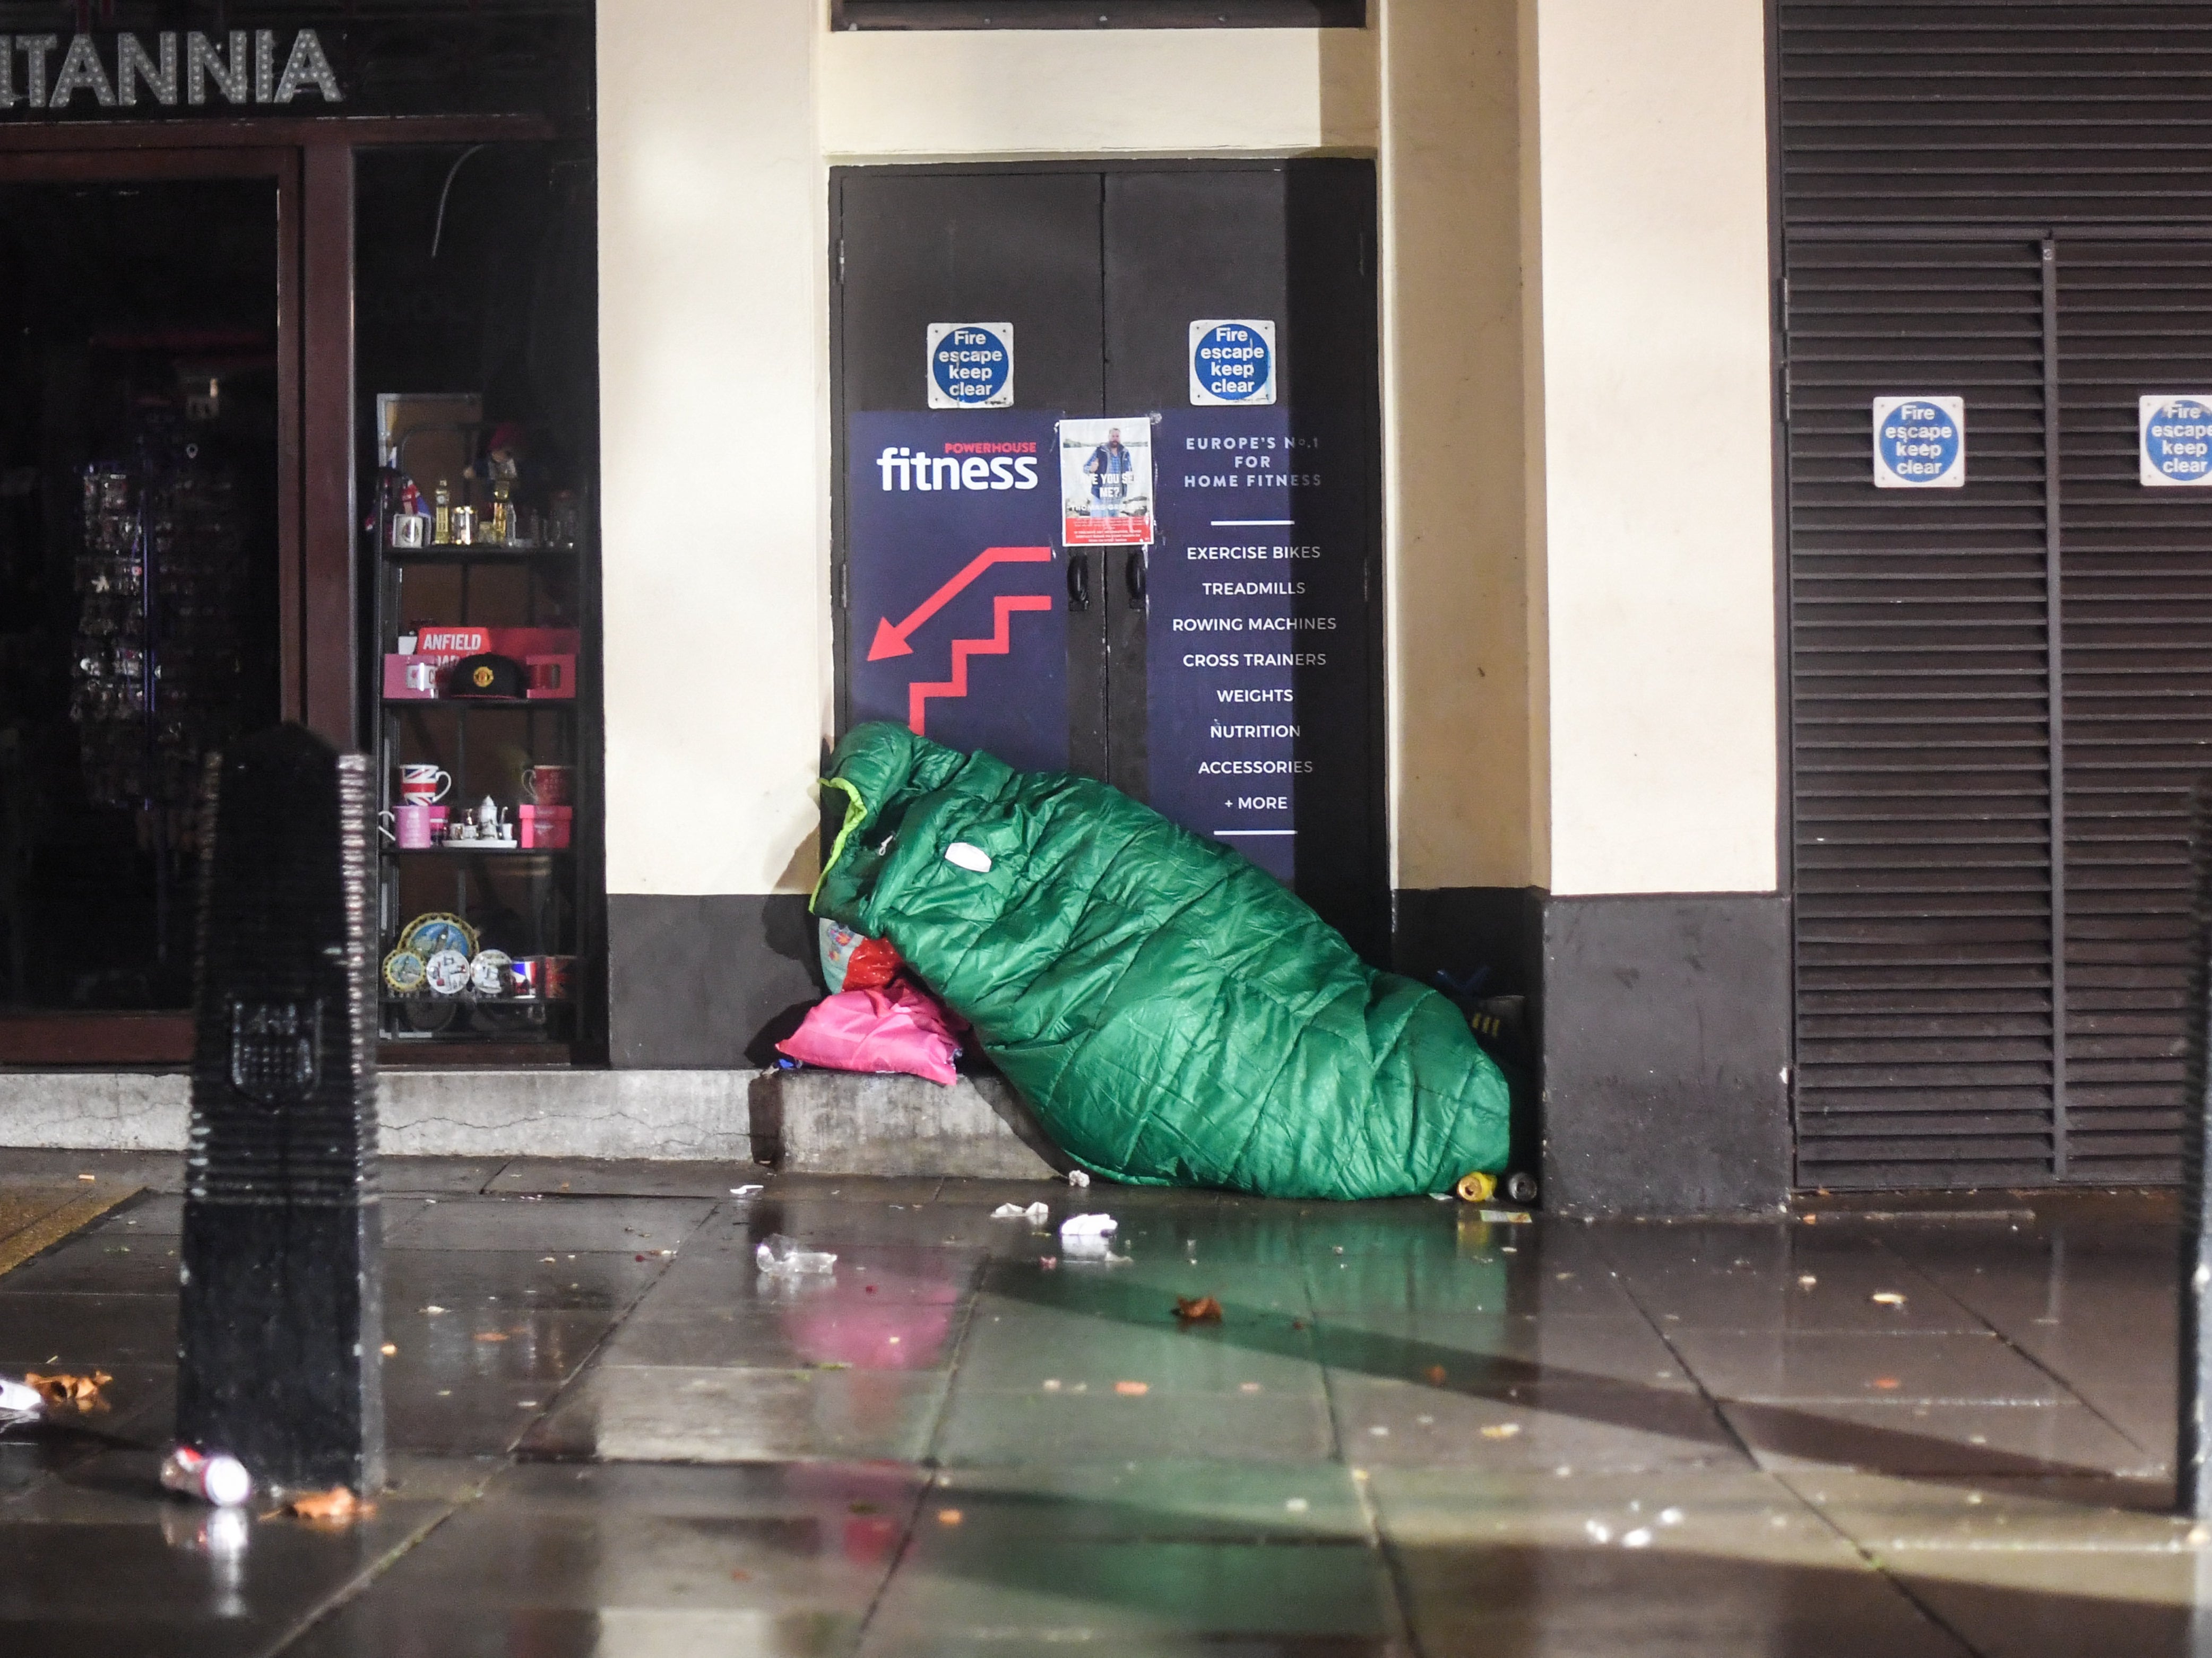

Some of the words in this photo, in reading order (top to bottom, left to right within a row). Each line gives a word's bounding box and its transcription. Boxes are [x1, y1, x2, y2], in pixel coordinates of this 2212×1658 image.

[0, 29, 341, 108] ITANNIA
[954, 330, 986, 345] Fire
[1216, 327, 1248, 342] Fire
[938, 350, 1003, 364] escape
[1200, 346, 1265, 361] escape
[948, 364, 992, 381] keep
[1211, 361, 1255, 379] keep
[948, 381, 993, 396] clear
[1211, 378, 1255, 393] clear
[1900, 404, 1935, 421] Fire
[2167, 403, 2202, 419] Fire
[1884, 426, 1953, 441] escape
[944, 442, 1036, 454] POWERHOUSE
[1186, 437, 1276, 450] EUROPE'S
[1895, 441, 1942, 459] keep
[2162, 439, 2208, 457] keep
[876, 447, 1038, 491] fitness
[1234, 455, 1271, 468] FOR
[1896, 459, 1942, 475] clear
[2162, 457, 2208, 473] clear
[1100, 473, 1120, 484] YOU
[1185, 475, 1238, 488] HOME
[1247, 474, 1321, 487] FITNESS
[1099, 487, 1119, 498] ME?
[1187, 546, 1268, 560] EXERCISE
[1272, 546, 1320, 559] BIKES
[1202, 581, 1306, 595] TREADMILLS
[1172, 618, 1243, 631] ROWING
[1248, 617, 1337, 631] MACHINES
[423, 633, 481, 650] ANFIELD
[1182, 653, 1239, 667] CROSS
[1243, 653, 1327, 666] TRAINERS
[1216, 689, 1294, 702] WEIGHTS
[1210, 725, 1301, 739] NUTRITION
[1198, 760, 1314, 774] ACCESSORIES
[1238, 796, 1288, 810] MORE
